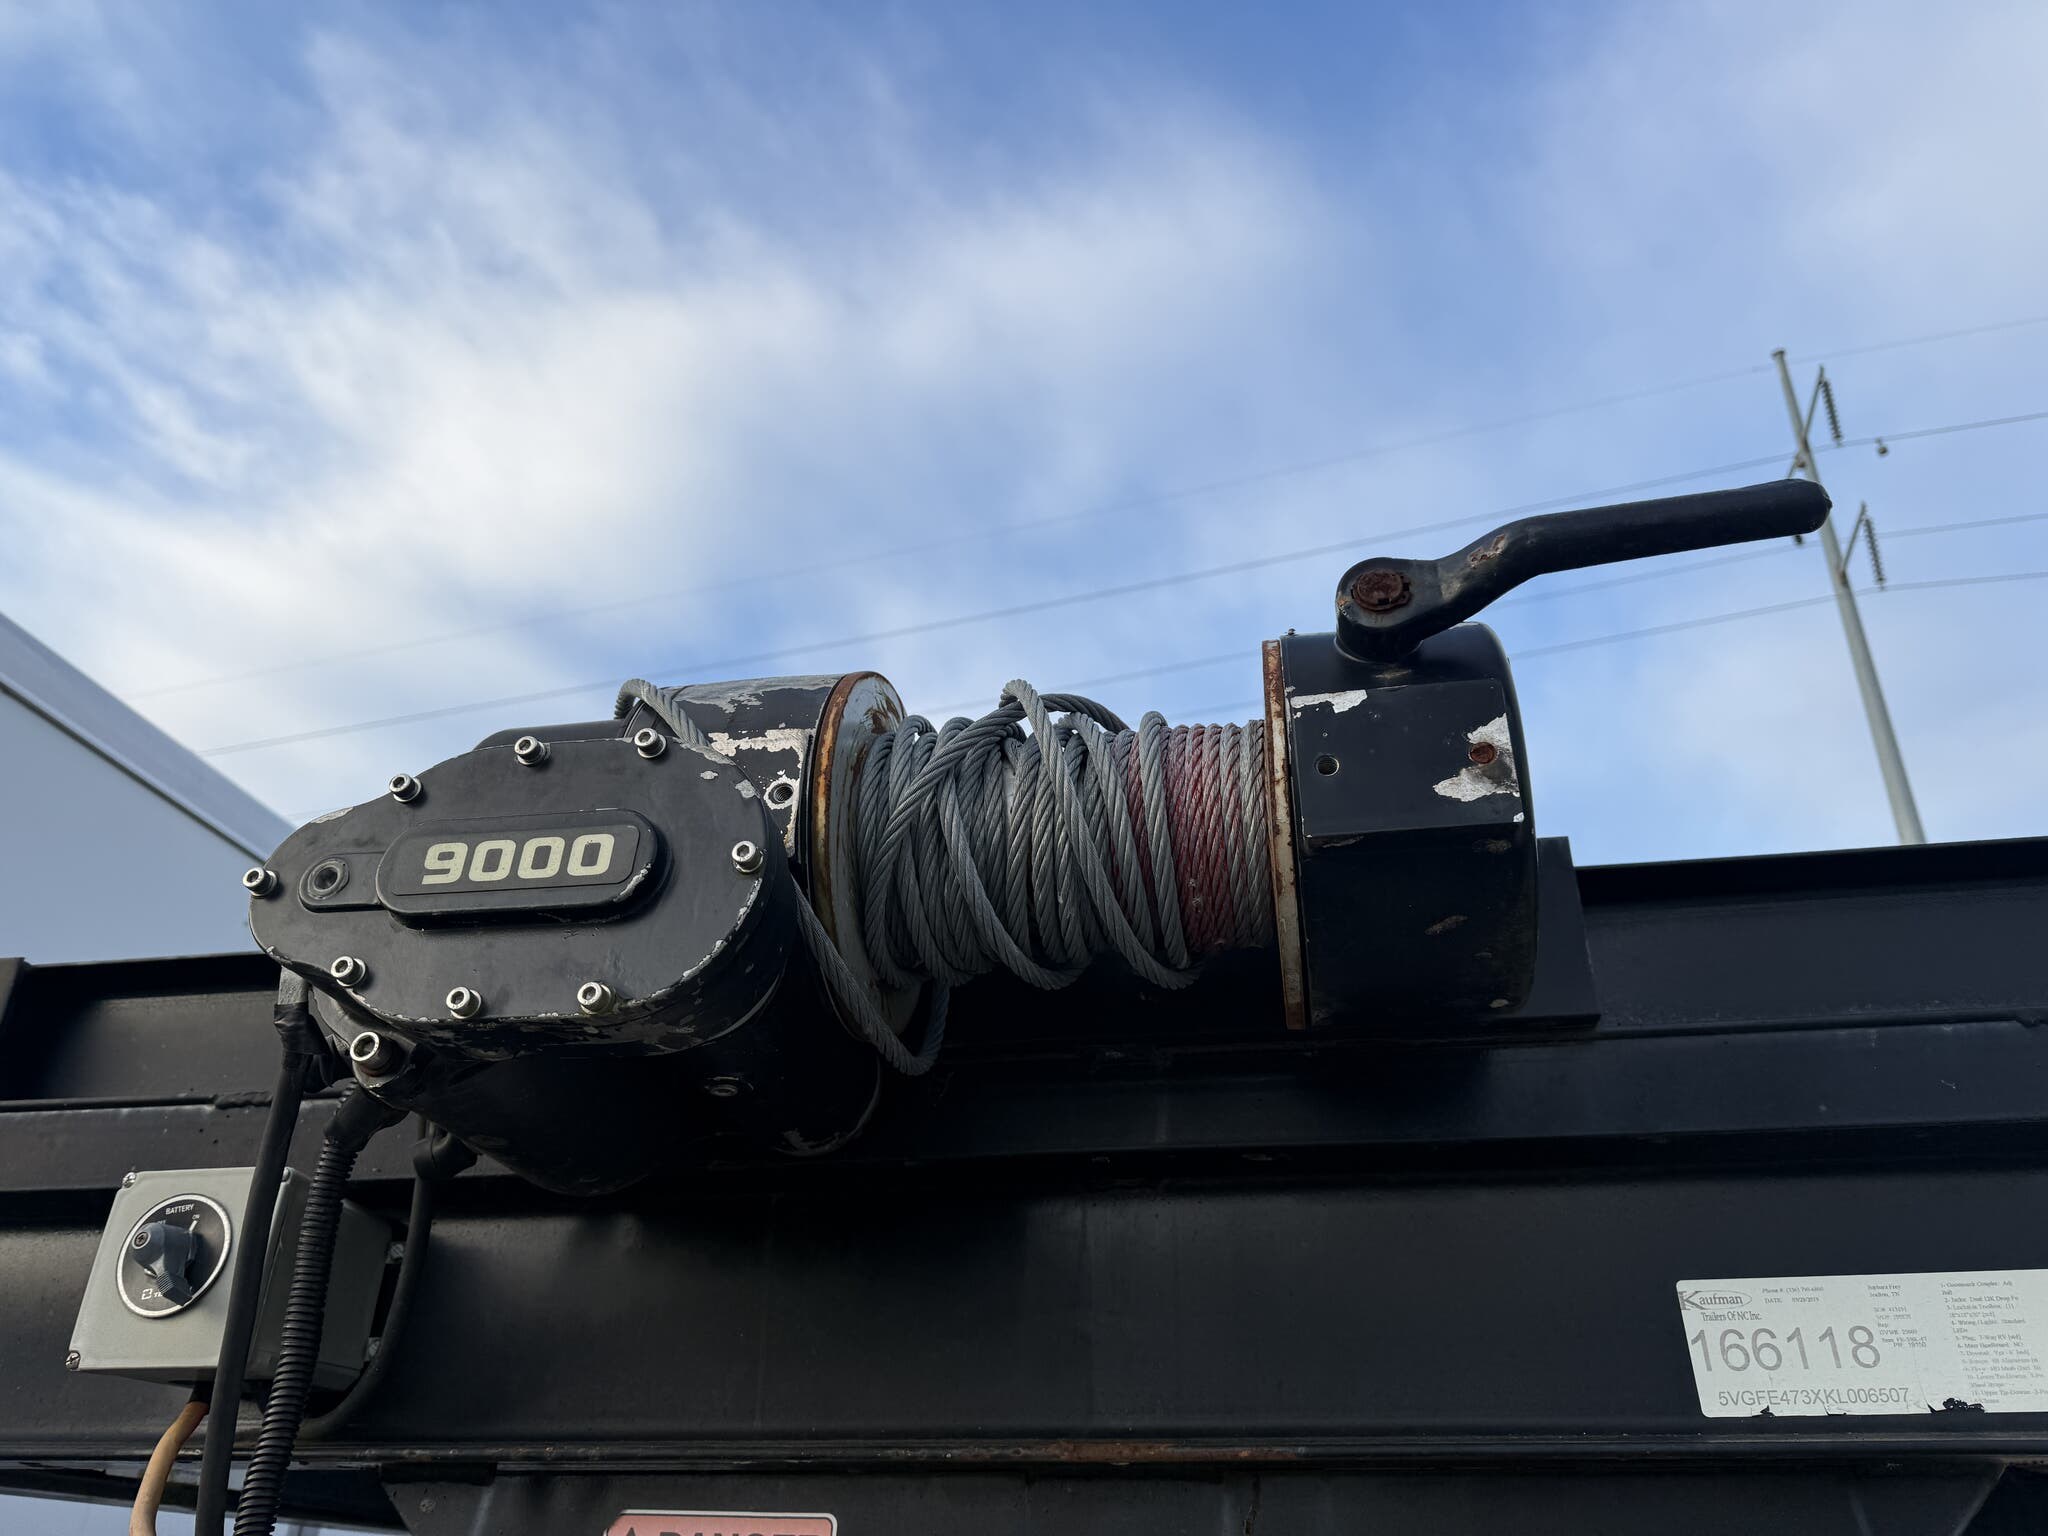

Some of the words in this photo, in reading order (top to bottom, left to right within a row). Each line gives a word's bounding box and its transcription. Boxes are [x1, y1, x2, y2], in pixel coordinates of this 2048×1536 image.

[421, 833, 615, 885] 9000
[165, 1203, 195, 1215] BATTERY
[1678, 1290, 1743, 1310] Kaufman
[1701, 1312, 1727, 1322] Trailers
[1726, 1311, 1737, 1321] Of
[1737, 1311, 1749, 1320] NC
[1749, 1310, 1762, 1320] Inc.
[1691, 1325, 1881, 1372] 166118
[1719, 1386, 1910, 1407] 5VGFE473XKL006507
